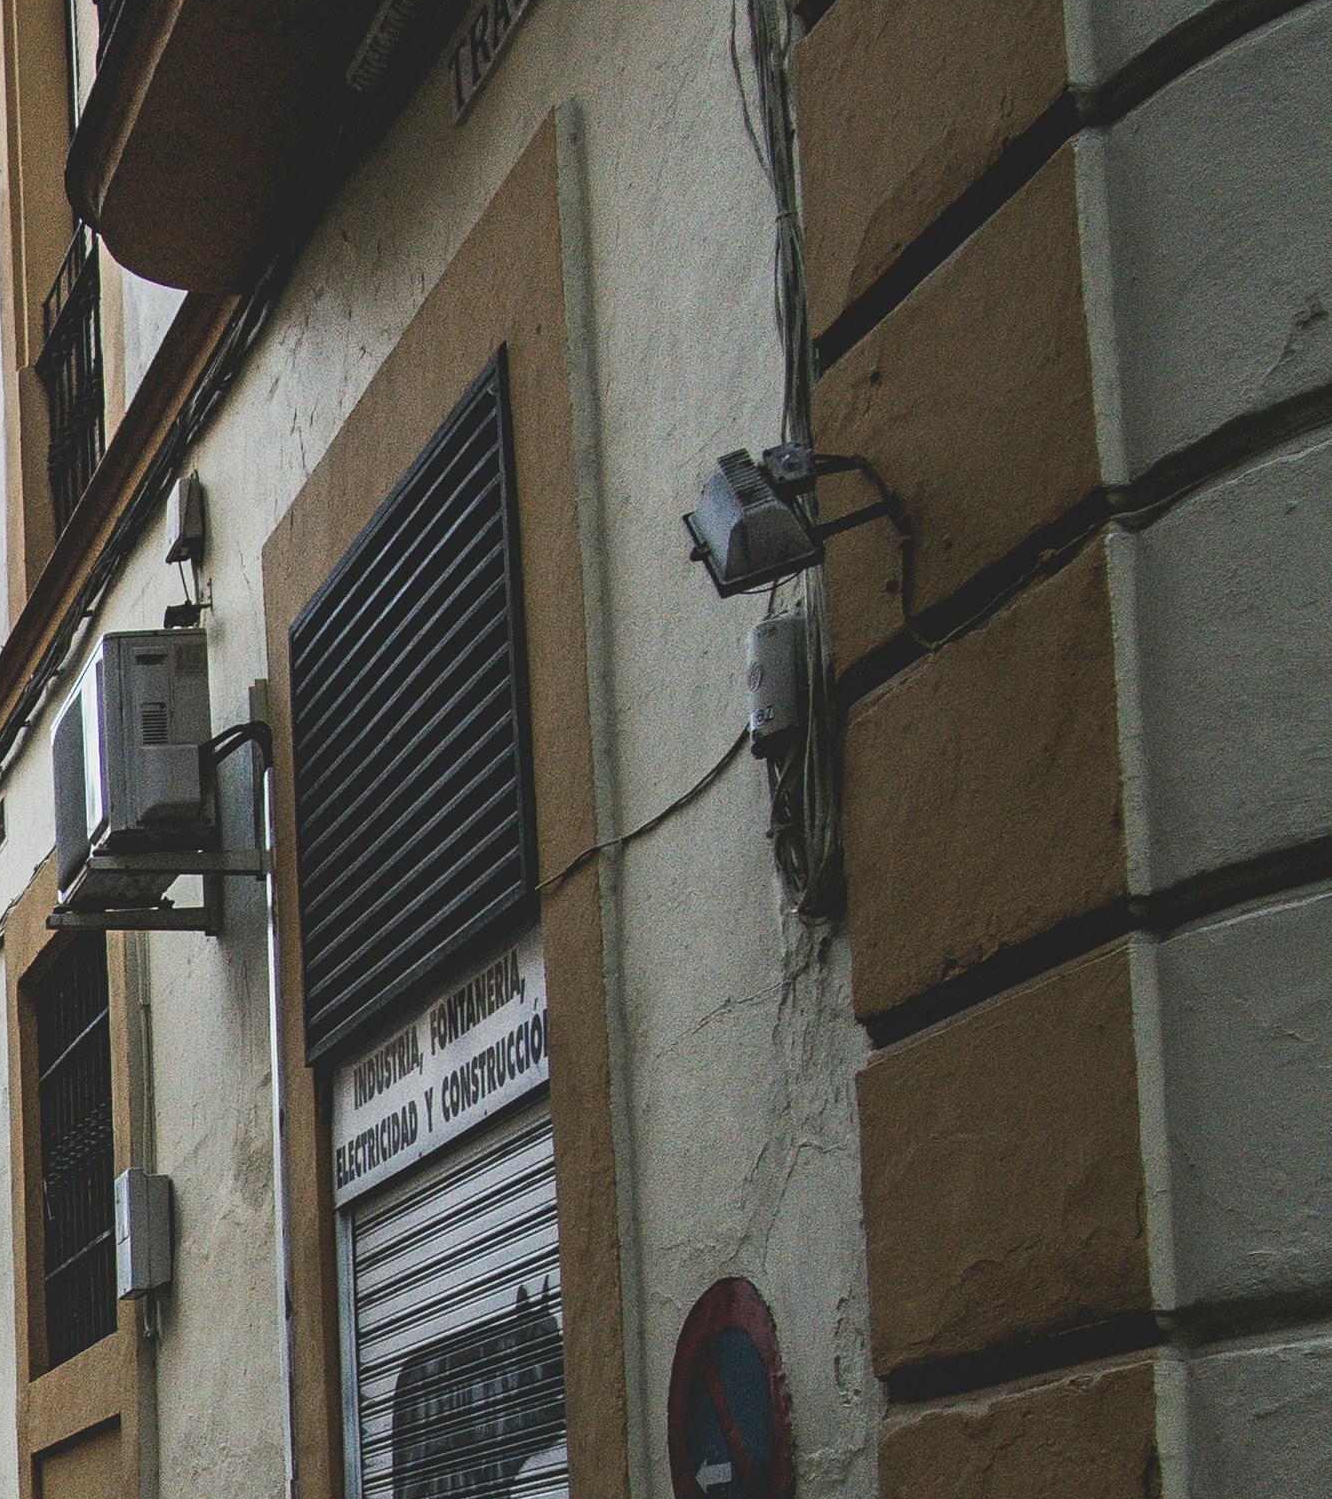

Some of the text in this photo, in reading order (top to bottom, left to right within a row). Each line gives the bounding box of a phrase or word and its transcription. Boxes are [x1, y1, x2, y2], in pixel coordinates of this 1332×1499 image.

[353, 1025, 424, 1111] INDUSTRIA,
[336, 1100, 418, 1190] ELECTRICIDAD
[424, 1086, 434, 1133] Y
